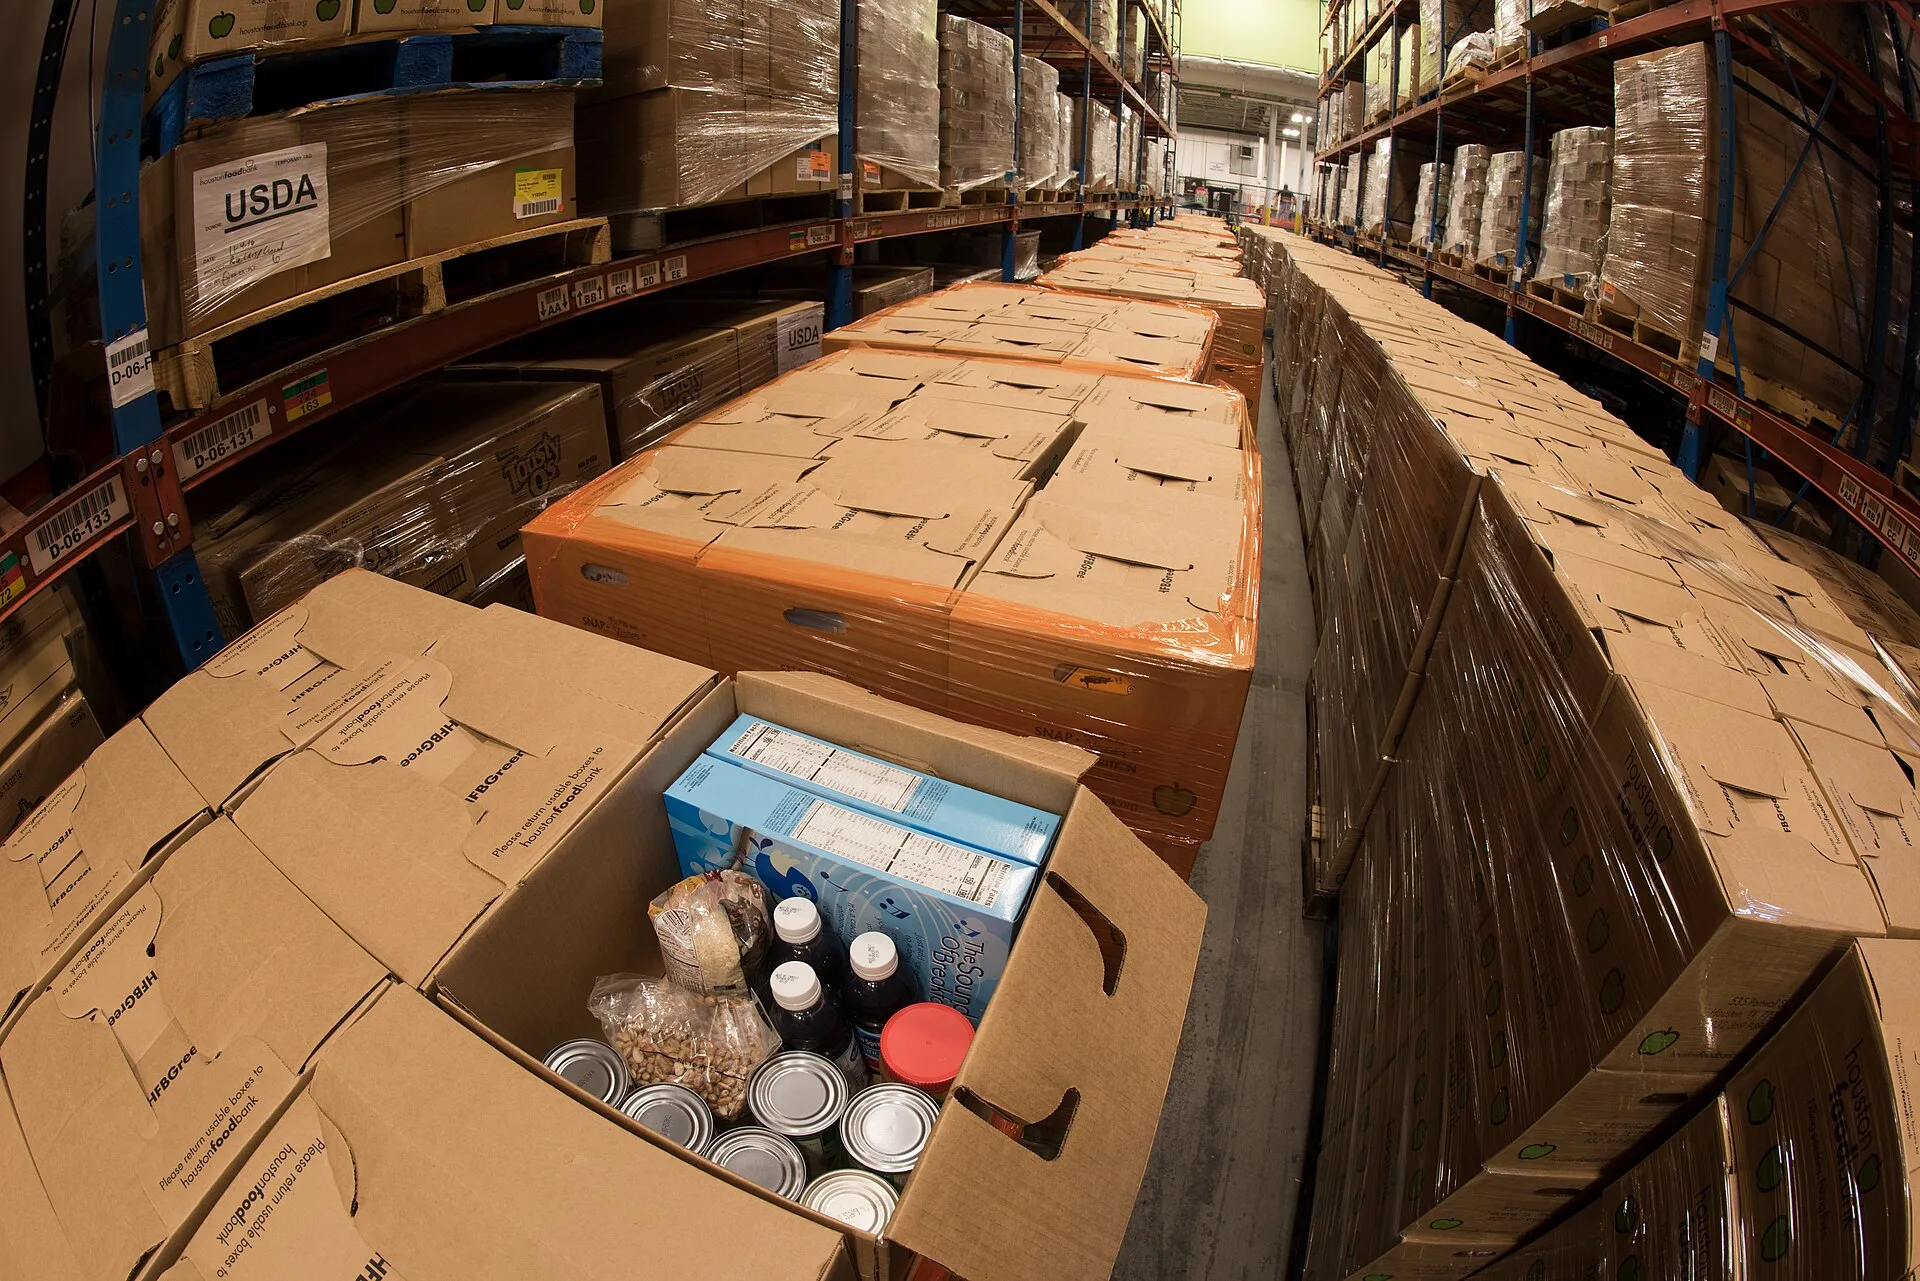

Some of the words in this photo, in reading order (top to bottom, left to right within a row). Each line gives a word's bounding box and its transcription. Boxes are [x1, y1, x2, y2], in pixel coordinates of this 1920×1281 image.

[239, 19, 308, 35] houstonfoodbank.org
[200, 166, 258, 186] houstonfoodbank
[225, 174, 318, 223] USDA
[643, 276, 654, 286] DD
[671, 270, 681, 279] EE
[584, 293, 597, 304] BB
[615, 284, 627, 295] CC
[549, 304, 562, 314] AA
[788, 325, 820, 347] USDA
[299, 399, 319, 414] 163
[194, 428, 254, 470] D-06-131
[1843, 493, 1853, 503] AA
[1866, 510, 1875, 521] BB
[50, 509, 111, 560] D-06-133
[1887, 529, 1896, 541] CC
[1908, 548, 1918, 560] DD
[407, 673, 431, 692] Please
[315, 673, 386, 724] houstonfoodbank
[338, 678, 410, 735] houstonfoodbank
[386, 690, 408, 710] return
[363, 708, 387, 728] usable
[340, 726, 365, 746] boxes
[1624, 747, 1660, 829] houston
[491, 830, 523, 857] Please
[521, 807, 546, 831] return
[544, 780, 572, 807] usable
[568, 756, 597, 782] boxes
[592, 746, 604, 757] to
[519, 767, 604, 848] houstonfoodbank
[53, 890, 110, 951] houstonfoodbank
[126, 904, 147, 927] Please
[69, 910, 131, 975] houstonfoodbank
[108, 925, 126, 947] return
[87, 945, 109, 969] usable
[941, 936, 960, 961] Of
[963, 941, 985, 964] The
[68, 967, 88, 989] boxes
[954, 962, 985, 1021] Sound
[1844, 1038, 1873, 1153] houston
[158, 1162, 184, 1191] Please
[183, 1136, 206, 1163] return
[205, 1106, 231, 1137] usable
[229, 1076, 255, 1107] boxes
[253, 1064, 264, 1076] to
[180, 1095, 259, 1190] houstonfoodbank
[294, 1138, 327, 1174] Please
[216, 1143, 297, 1247] houstonfoodbank
[272, 1172, 297, 1200] return
[248, 1202, 274, 1237] usable
[225, 1235, 253, 1268] boxes
[216, 1265, 229, 1279] to
